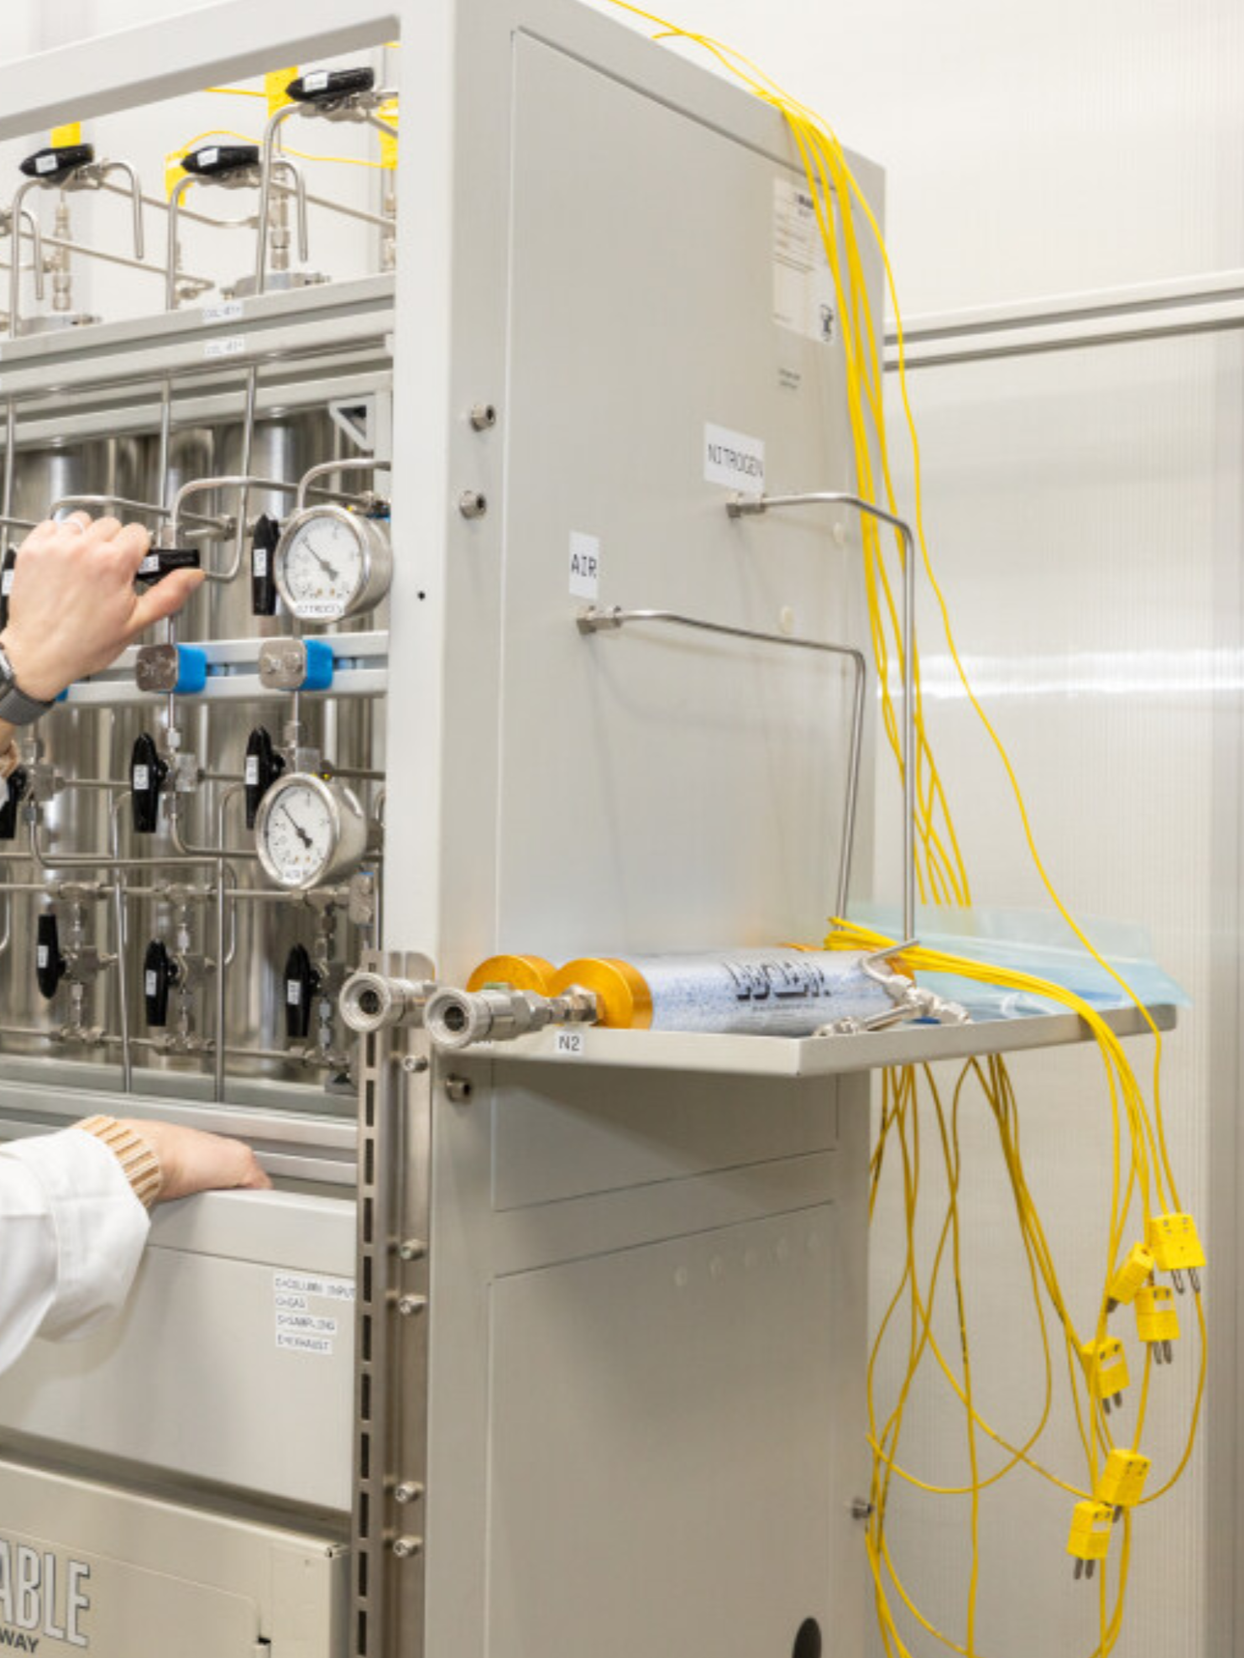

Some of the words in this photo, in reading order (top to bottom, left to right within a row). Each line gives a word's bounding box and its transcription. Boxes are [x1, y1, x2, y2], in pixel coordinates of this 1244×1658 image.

[707, 444, 764, 478] NITROGEN
[571, 554, 597, 578] AIR
[559, 1035, 580, 1052] N2
